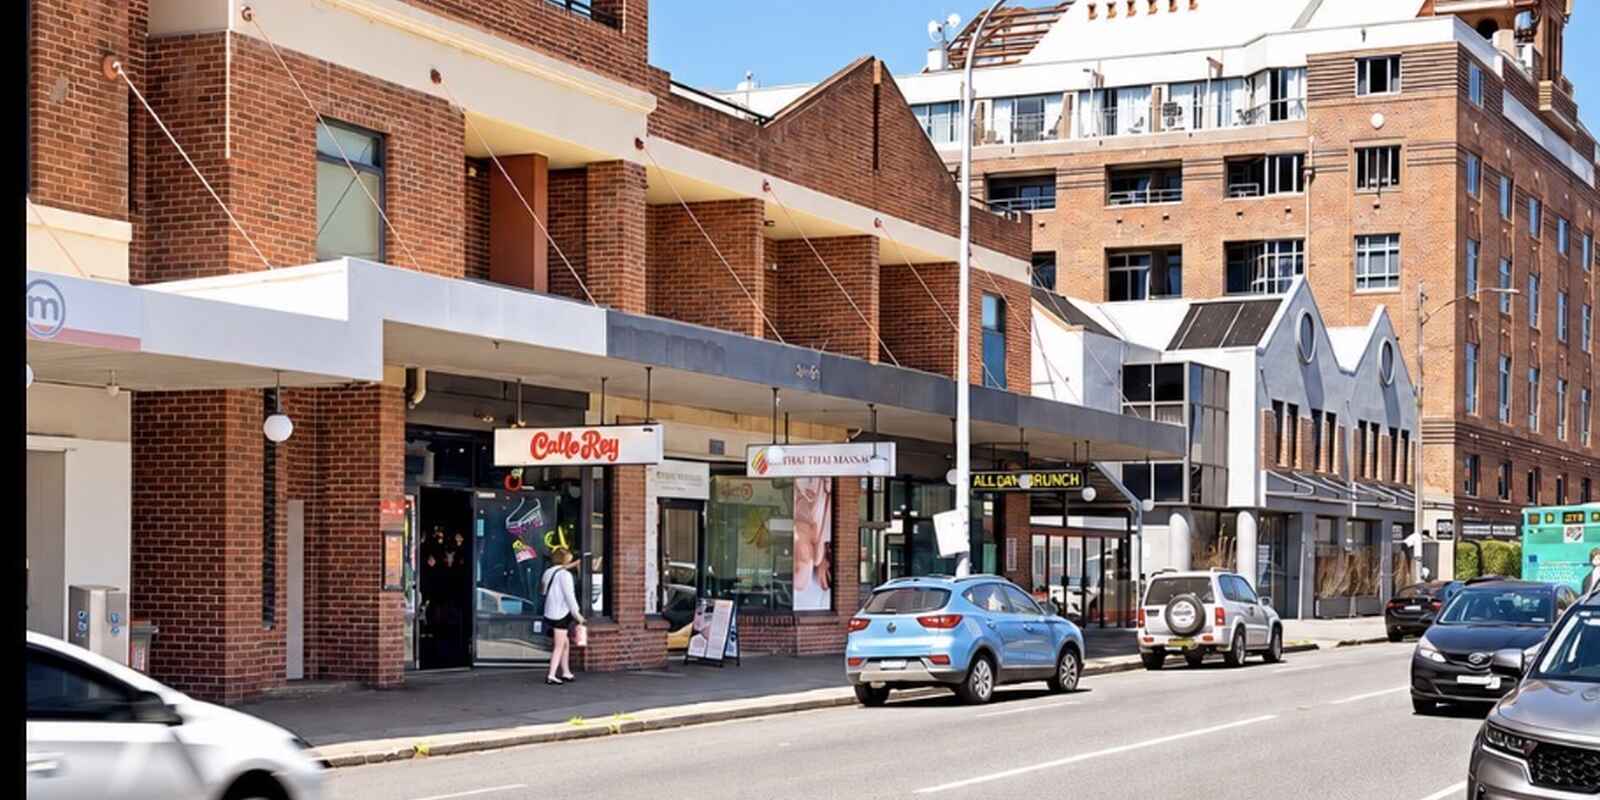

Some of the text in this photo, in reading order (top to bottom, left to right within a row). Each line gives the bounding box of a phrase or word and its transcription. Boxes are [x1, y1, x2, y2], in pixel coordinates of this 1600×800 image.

[581, 430, 619, 461] Rey
[784, 456, 805, 466] THAI
[809, 456, 832, 465] THAI
[974, 475, 996, 487] ALL
